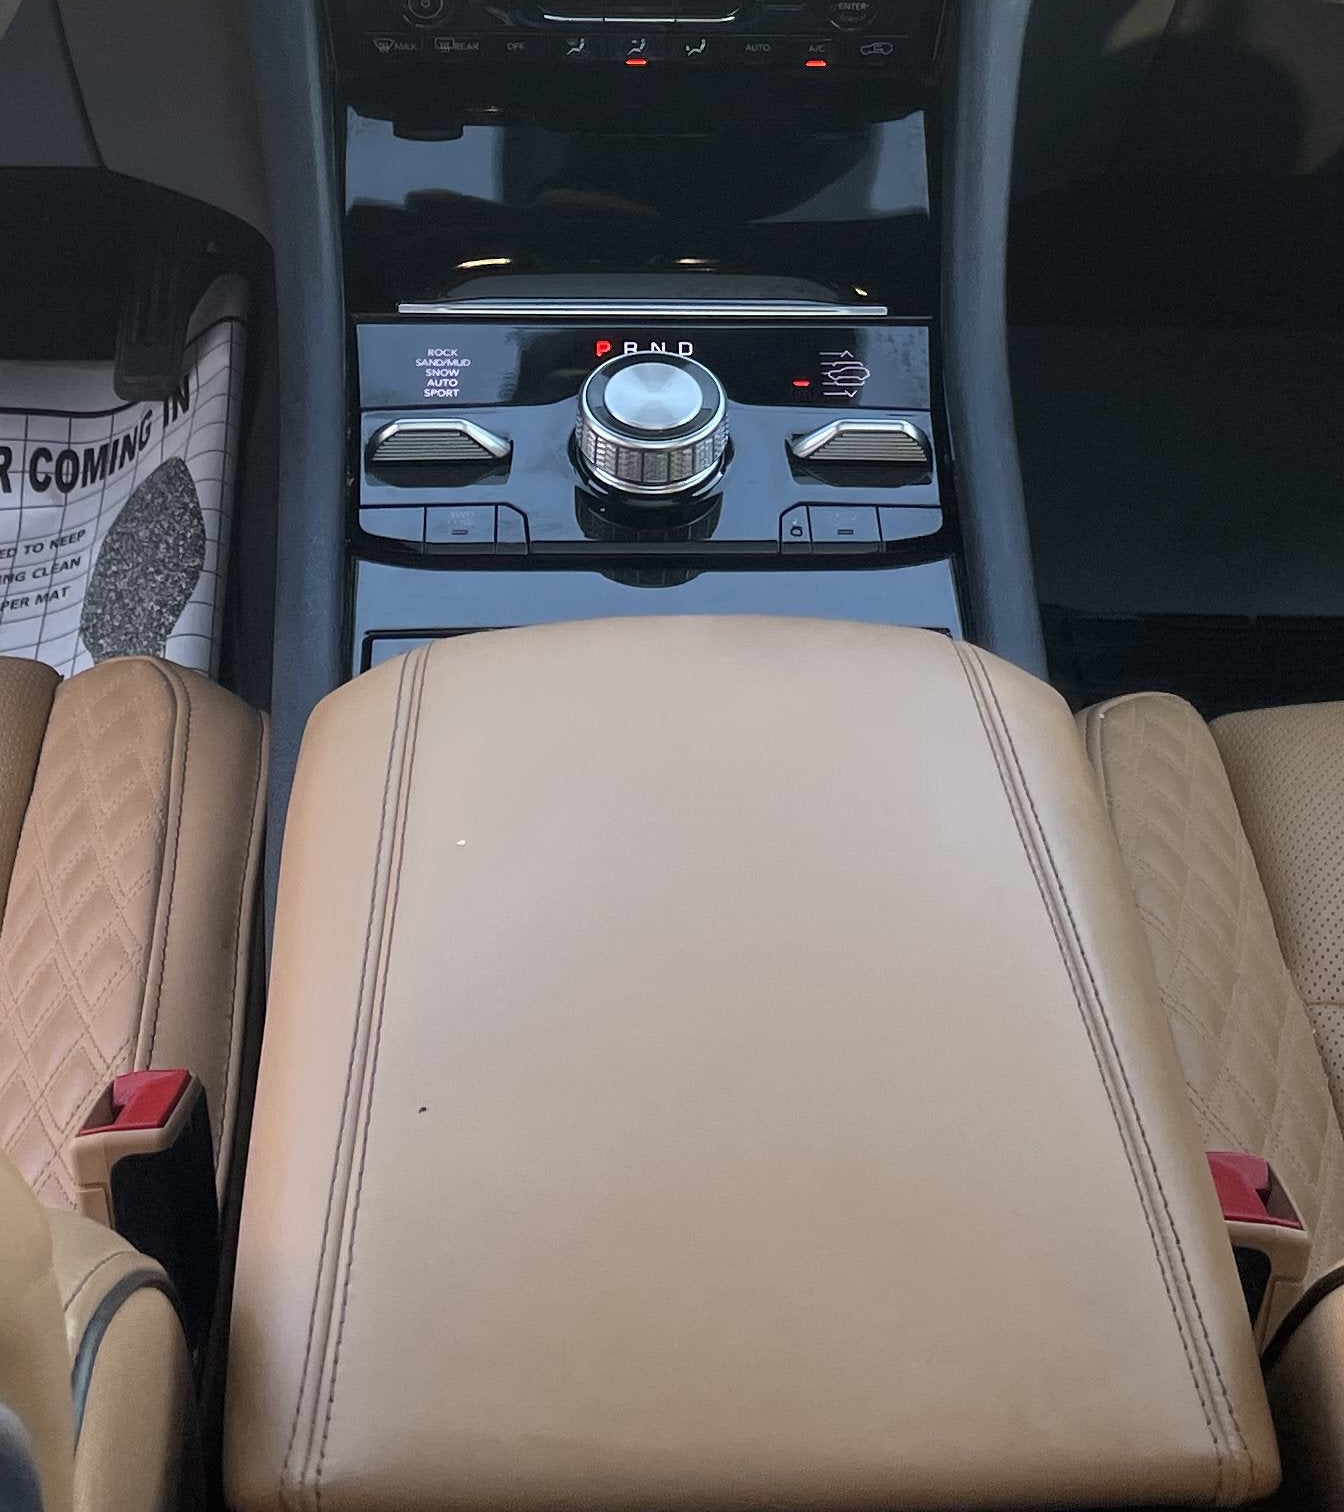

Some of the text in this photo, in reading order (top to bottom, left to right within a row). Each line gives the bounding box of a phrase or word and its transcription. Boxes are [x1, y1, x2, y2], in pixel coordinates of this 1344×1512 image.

[838, 2, 867, 11] ENTER
[745, 43, 771, 52] AUTO
[808, 44, 826, 53] A/C
[427, 348, 458, 357] ROCK
[594, 340, 694, 357] P R N D
[415, 358, 471, 367] SAND/MUD
[425, 368, 460, 377] SNOW
[426, 378, 458, 387] AUTO
[423, 388, 460, 398] SPORT
[29, 409, 152, 494] COMING
[163, 377, 191, 433] IN
[24, 542, 44, 555] TO
[49, 529, 86, 550] KEEP
[32, 556, 81, 579] CLEAN
[35, 586, 71, 605] MAT
